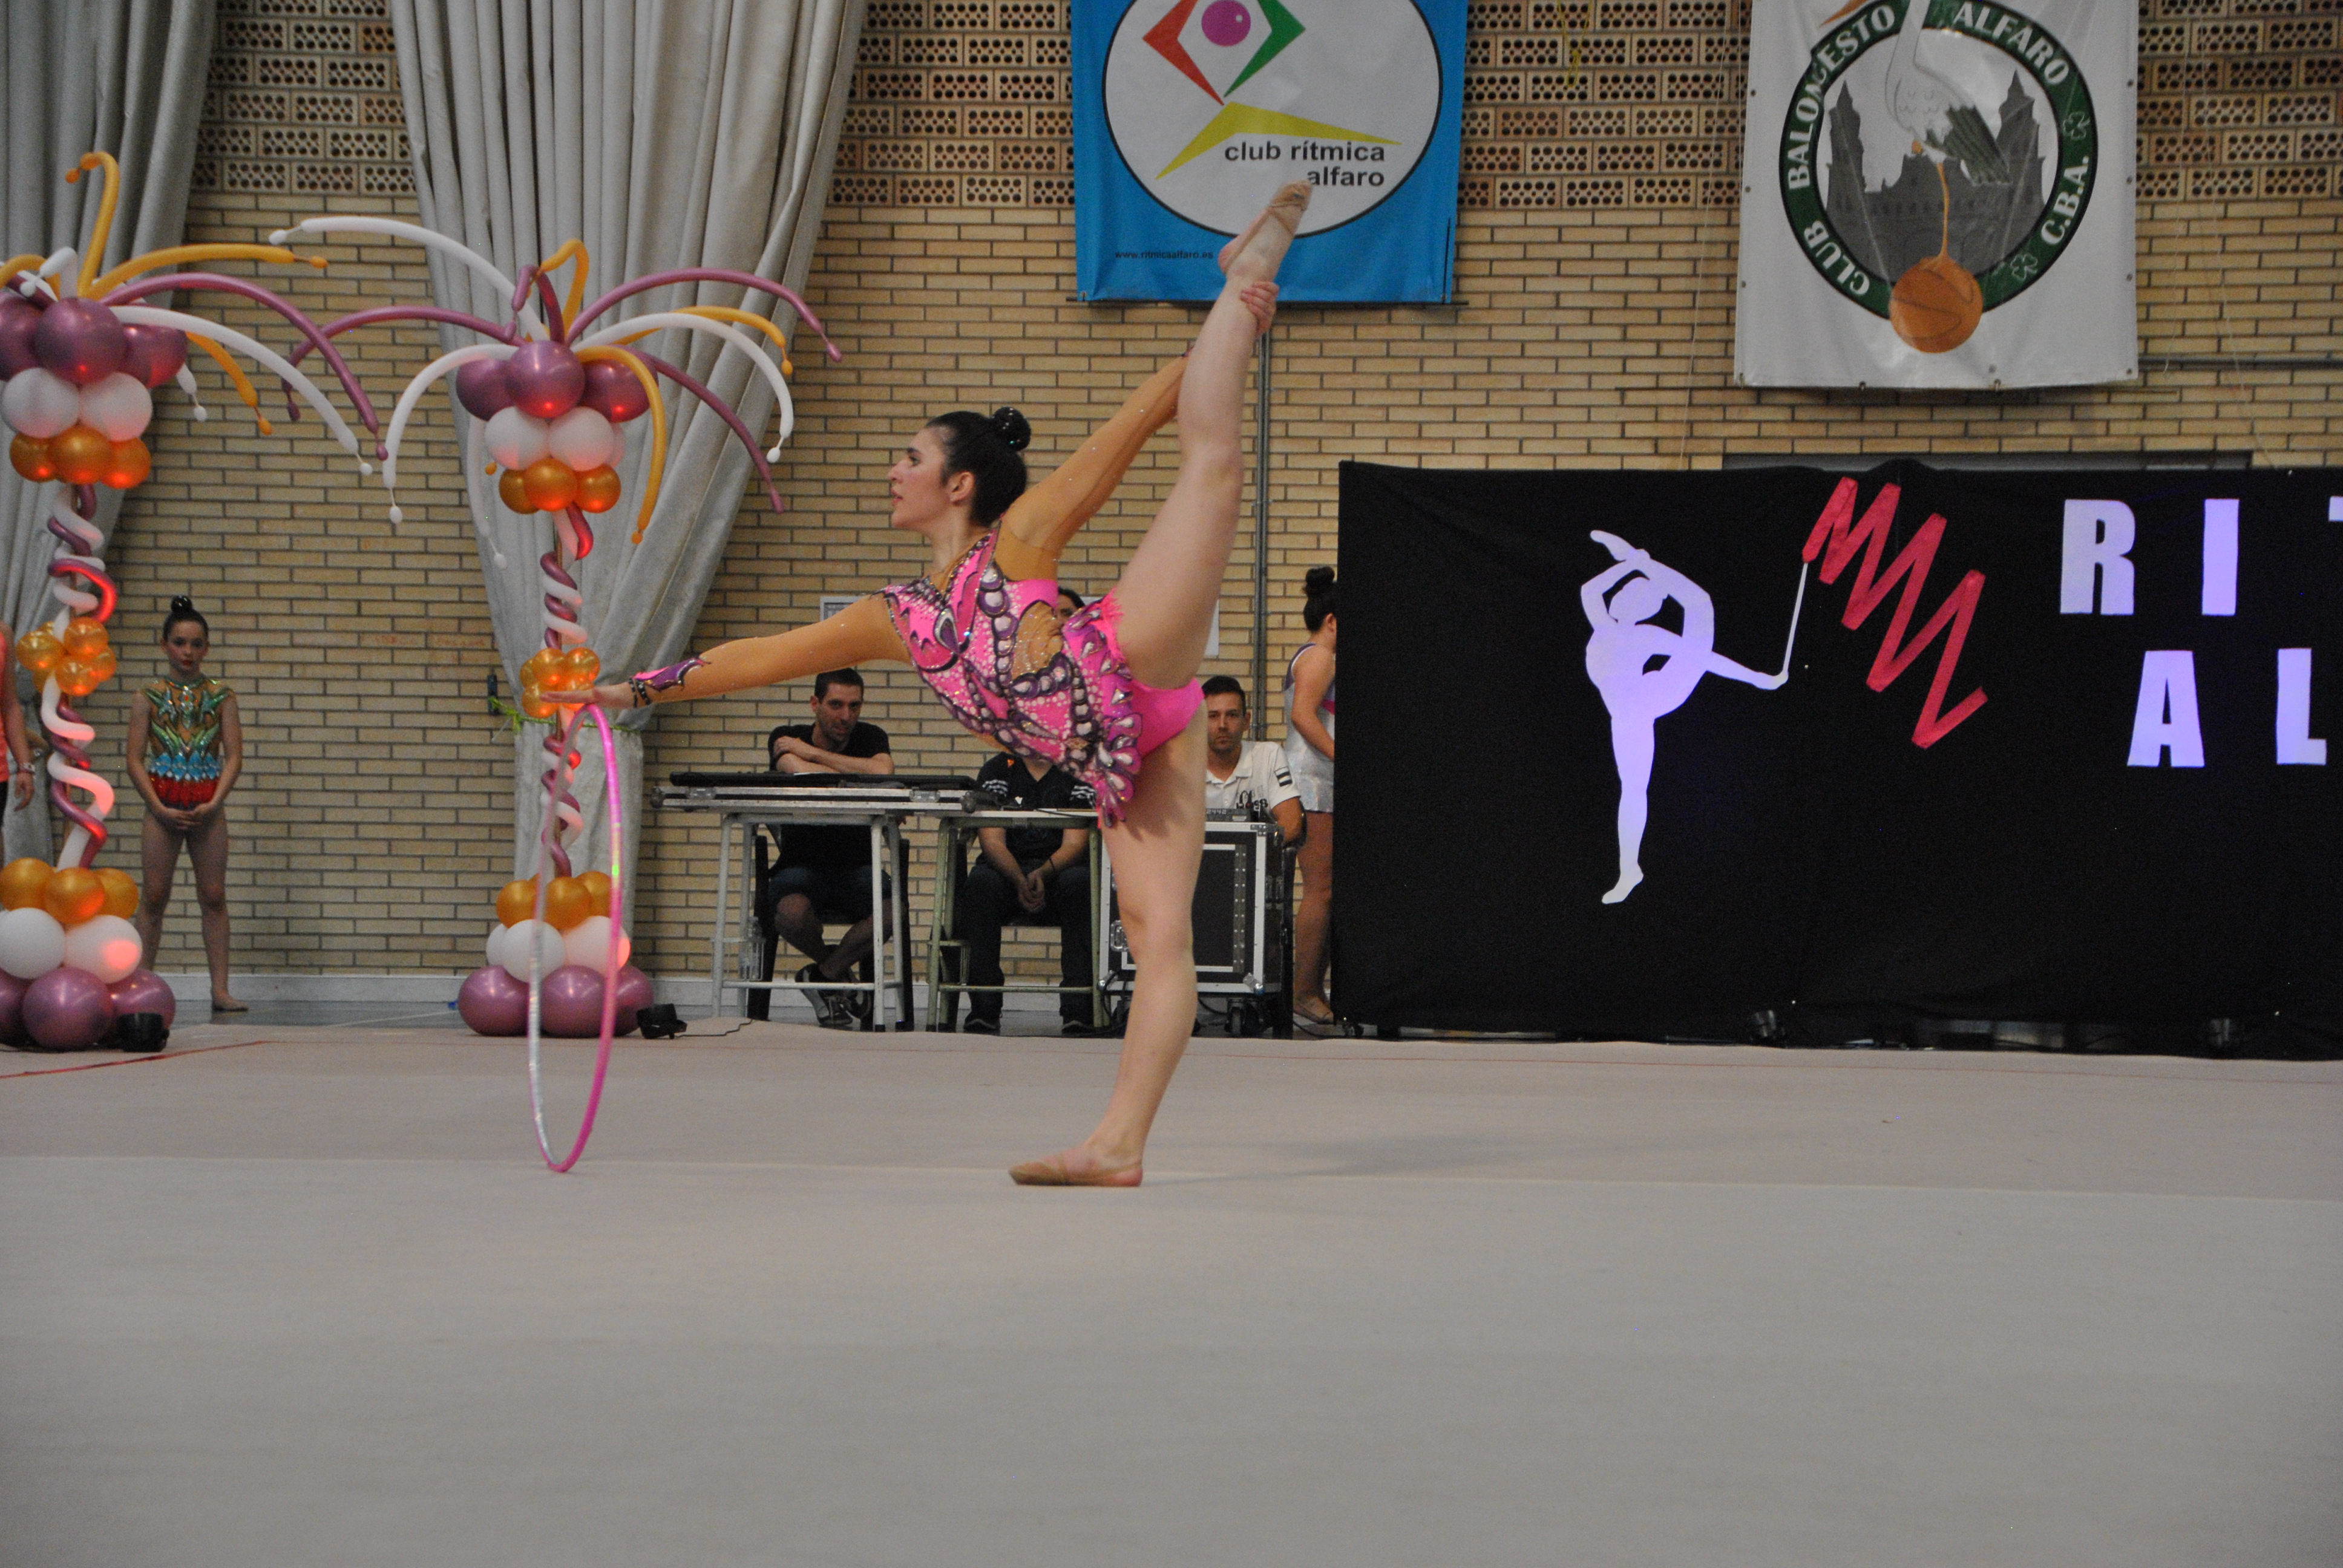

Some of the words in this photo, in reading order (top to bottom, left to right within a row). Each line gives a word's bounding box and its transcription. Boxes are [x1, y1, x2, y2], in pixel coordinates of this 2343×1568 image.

[1224, 140, 1281, 162] club
[1291, 140, 1384, 162] rítmica
[1306, 165, 1384, 186] alfaro
[1804, 220, 1870, 295] CLUB
[1952, 1, 2069, 85] ALFARO
[2040, 155, 2089, 245] C.B.A.
[2060, 495, 2343, 616] RI
